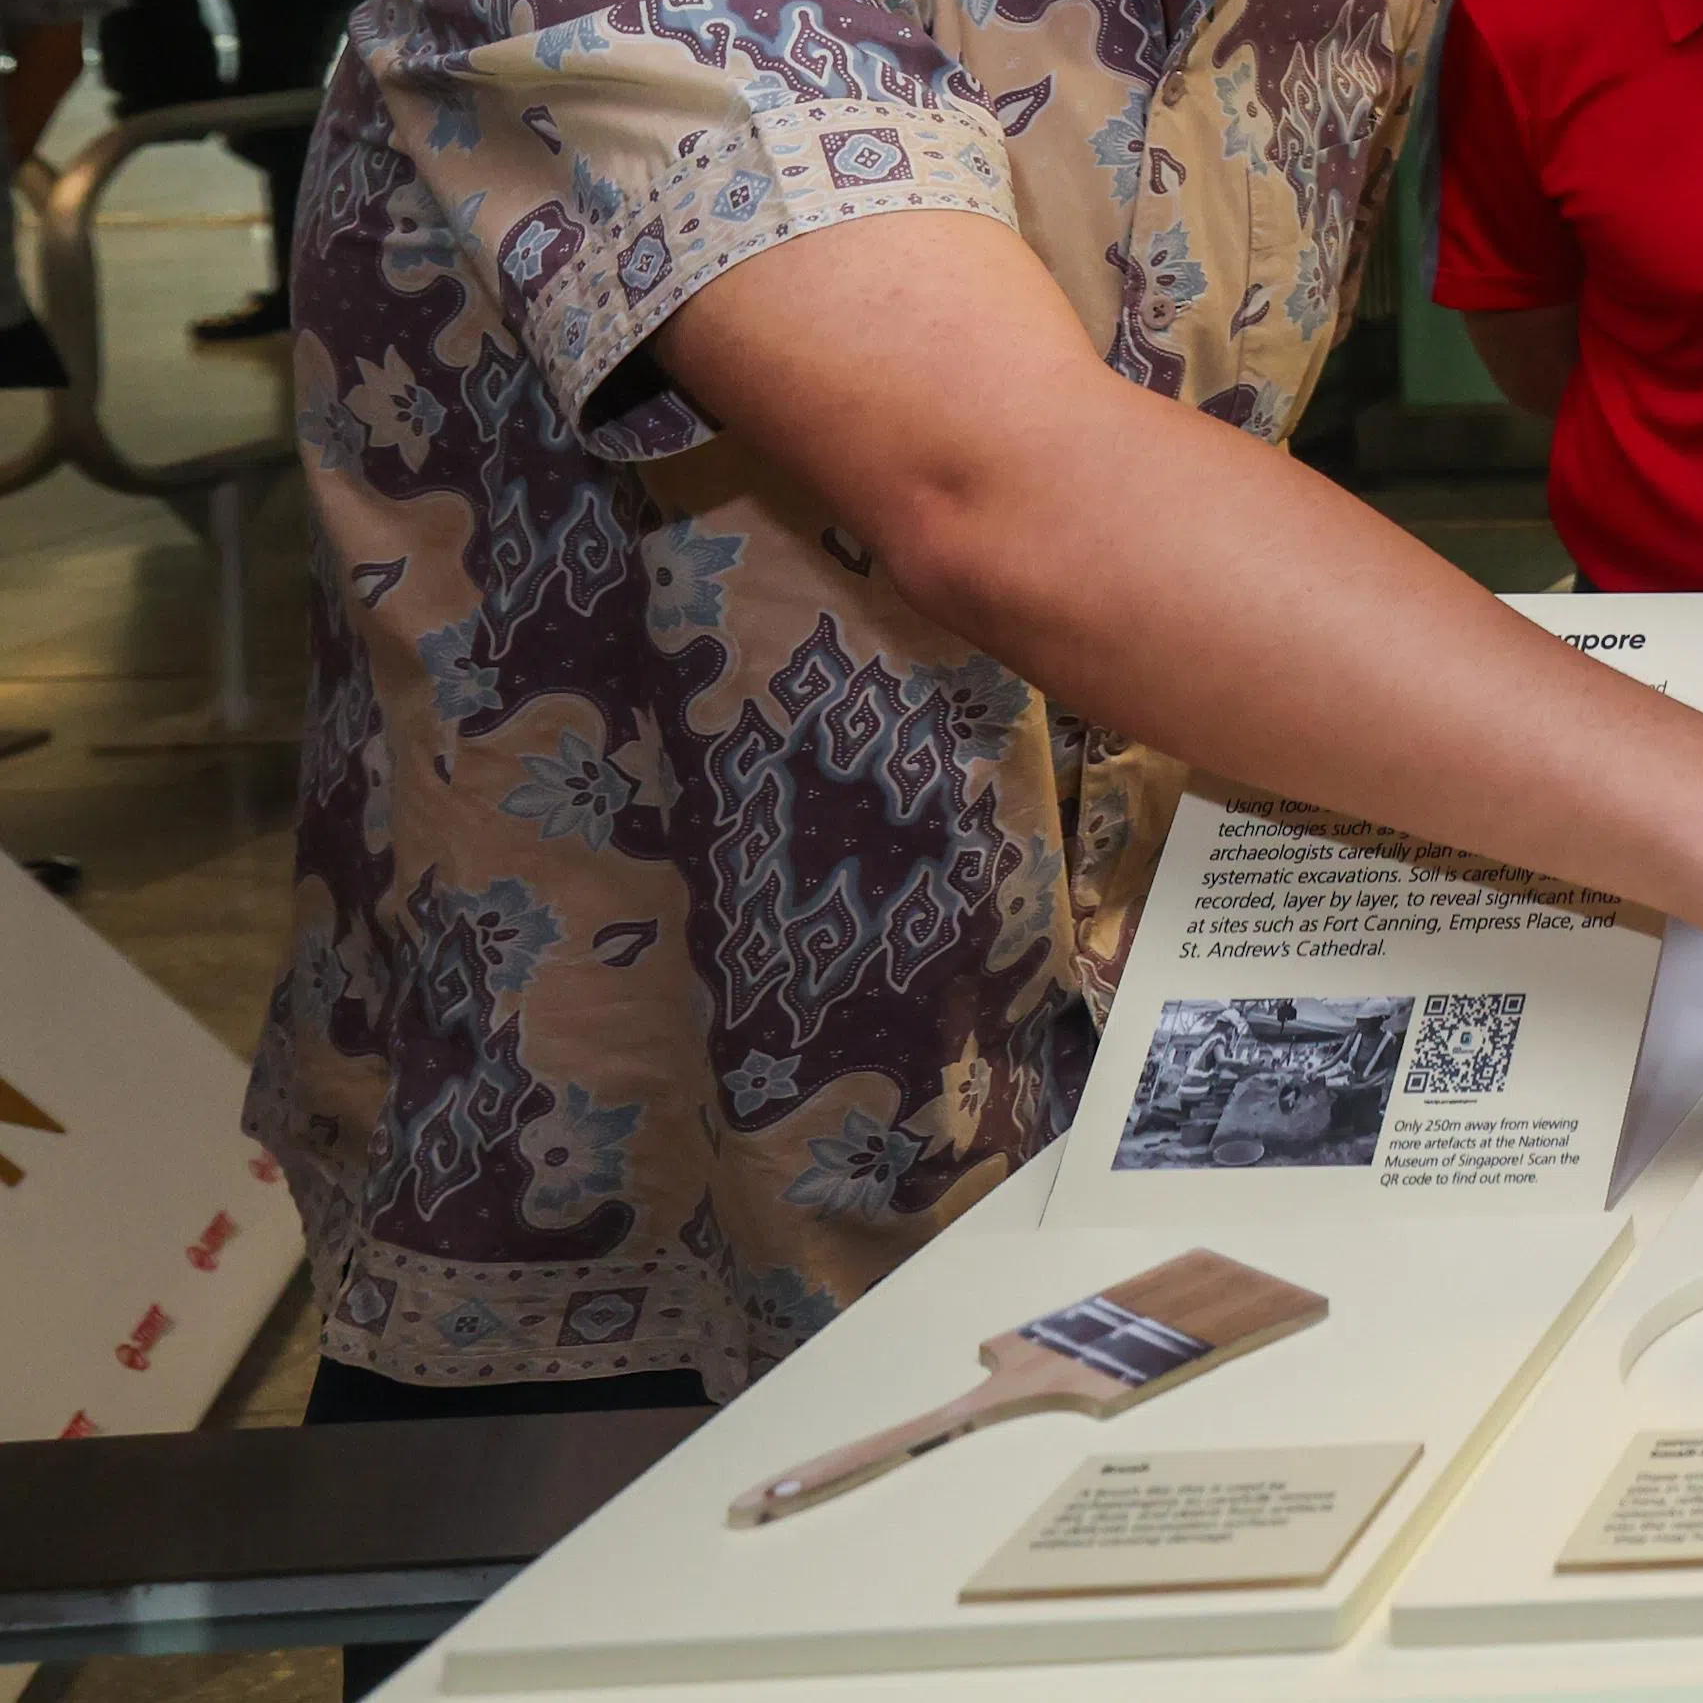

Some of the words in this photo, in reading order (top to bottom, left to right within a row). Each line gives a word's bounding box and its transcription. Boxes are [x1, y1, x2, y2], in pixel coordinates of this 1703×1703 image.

[1225, 799, 1274, 816] Using
[1218, 821, 1326, 841] technologies
[1331, 820, 1371, 837] such
[1209, 843, 1334, 864] archaeologists
[1337, 843, 1410, 863] carefully
[1415, 843, 1453, 863] plan
[1201, 867, 1294, 887] systematic
[1298, 867, 1402, 884] excavations.
[1409, 865, 1440, 883] Soil
[1444, 866, 1459, 883] is
[1462, 865, 1534, 887] carefully
[1194, 891, 1278, 911] recorded,
[1281, 890, 1326, 911] layer
[1328, 890, 1352, 911] by
[1355, 889, 1400, 911] layer,
[1406, 892, 1425, 907] to
[1429, 890, 1482, 906] reveal
[1484, 888, 1574, 910] significant
[1185, 918, 1206, 934] at
[1209, 916, 1249, 933] sites
[1252, 915, 1293, 932] such
[1298, 917, 1319, 932] as
[1323, 914, 1359, 932] Fort
[1363, 913, 1442, 936] Canning,
[1448, 913, 1521, 934] Empress
[1526, 912, 1575, 932] Place,
[1581, 913, 1616, 929] and
[1178, 940, 1201, 960] St.
[1296, 938, 1387, 958] Cathedral.
[1395, 1120, 1422, 1133] Only
[1425, 1120, 1461, 1131] 250m
[1465, 1121, 1496, 1132] away
[1500, 1118, 1528, 1132] from
[1532, 1118, 1578, 1132] viewing
[1389, 1139, 1421, 1149] more
[1424, 1137, 1476, 1149] artefacts
[1480, 1137, 1492, 1148] at
[1496, 1136, 1515, 1147] the
[1519, 1135, 1569, 1147] National
[1385, 1157, 1438, 1167] Museum
[1442, 1154, 1457, 1166] of
[1528, 1154, 1556, 1165] Scan
[1560, 1153, 1580, 1164] the
[1380, 1175, 1399, 1186] QR
[1402, 1173, 1432, 1185] code
[1436, 1173, 1448, 1184] to
[1452, 1172, 1477, 1184] find
[1479, 1173, 1500, 1184] out
[1504, 1174, 1538, 1183] more.
